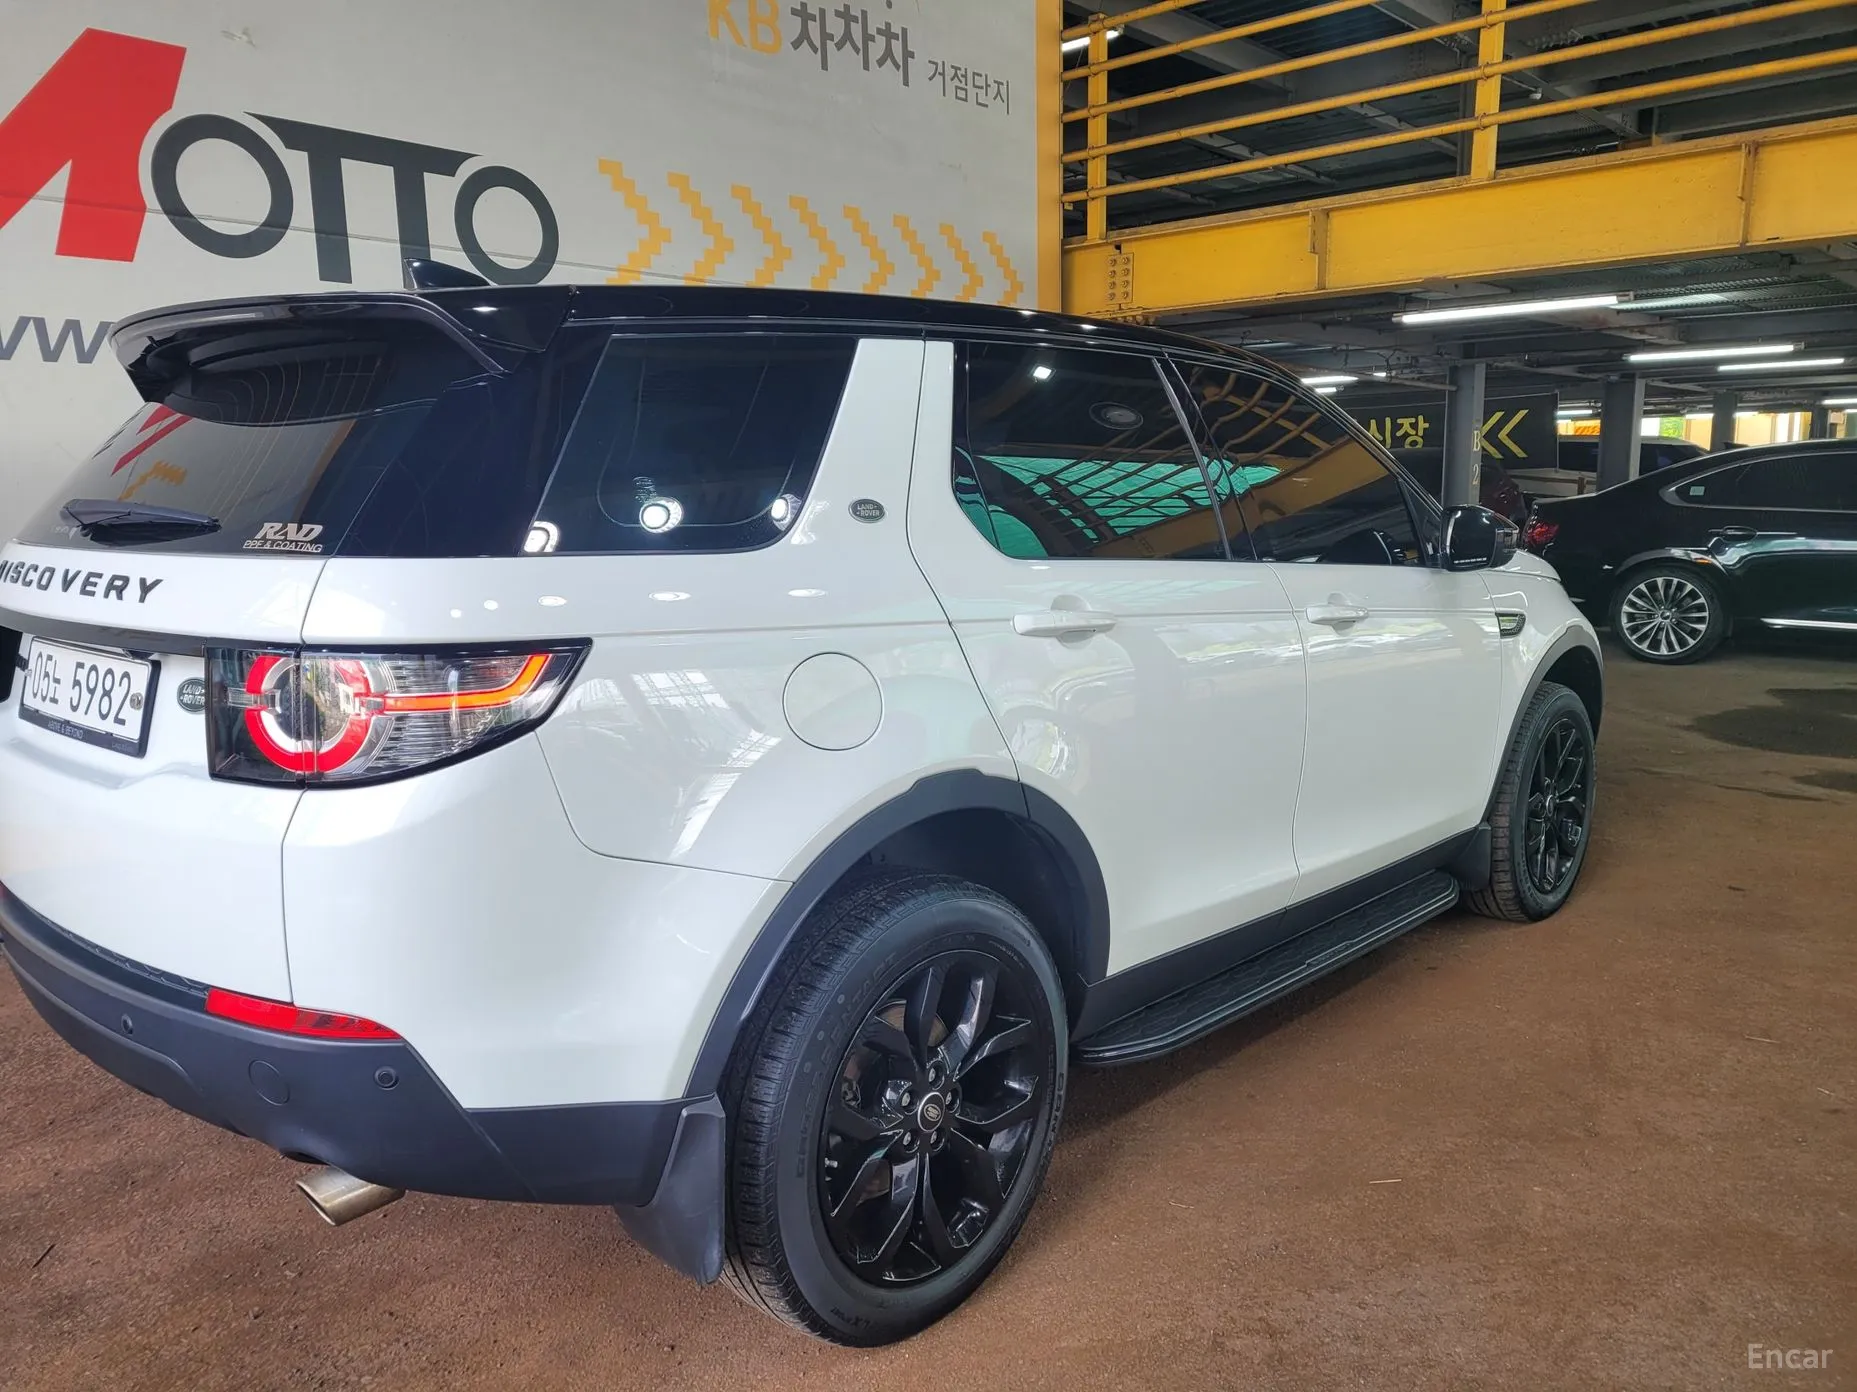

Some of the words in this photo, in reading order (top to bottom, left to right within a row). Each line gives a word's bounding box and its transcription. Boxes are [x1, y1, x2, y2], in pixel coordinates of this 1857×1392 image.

[927, 59, 1010, 115] 거점단지
[860, 509, 880, 517] ROVER
[254, 522, 323, 541] RAD
[273, 541, 323, 553] COATING
[32, 650, 62, 706] 05노
[69, 661, 131, 726] 5982
